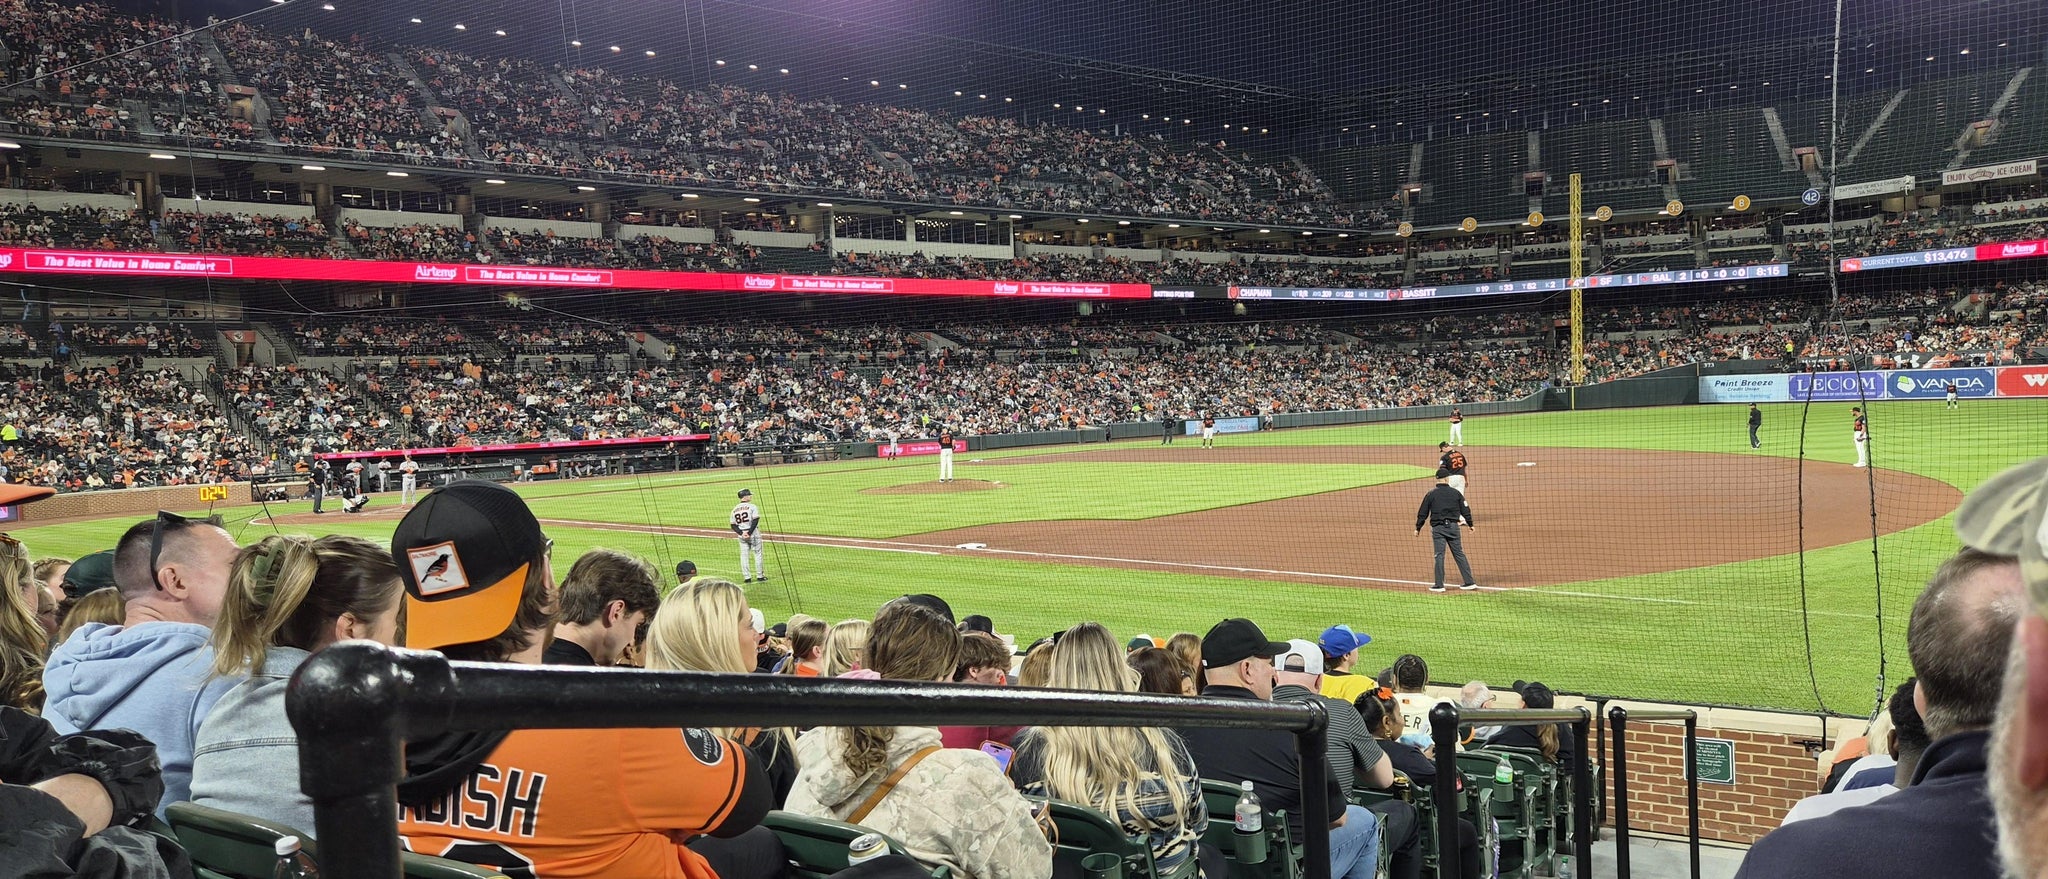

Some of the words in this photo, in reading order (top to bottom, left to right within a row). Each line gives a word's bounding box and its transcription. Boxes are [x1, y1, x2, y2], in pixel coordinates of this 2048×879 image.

[1996, 166, 2008, 176] ICE
[2010, 164, 2032, 175] CREAM
[1946, 172, 1966, 182] ENJOY
[1804, 192, 1818, 201] 42
[1598, 208, 1610, 217] 22
[1669, 203, 1680, 212] 33
[1400, 225, 1411, 234] 20
[2002, 244, 2037, 256] Airtemp
[44, 256, 64, 266] The
[67, 257, 92, 268] Best
[95, 258, 125, 269] Value
[128, 258, 138, 269] in
[141, 258, 171, 270] Home
[174, 260, 216, 271] Comfort
[1862, 257, 1894, 266] CURRENT
[1895, 255, 1918, 264] TOTAL
[1924, 250, 1968, 263] $13,476
[416, 265, 457, 280] Airtemp
[480, 270, 494, 279] The
[496, 271, 514, 280] Best
[516, 271, 537, 280] Value
[539, 272, 546, 280] in
[549, 272, 569, 282] Home
[571, 273, 600, 282] Comfort
[1600, 277, 1612, 285] SF
[1652, 274, 1672, 282] BAL
[1679, 272, 1686, 280] 2
[1756, 266, 1780, 276] 8:15
[744, 276, 776, 288] Airtemp
[1240, 289, 1272, 297] CHAPMAN
[1402, 288, 1437, 298] BASSITT
[1797, 377, 1876, 391] LECOM
[1917, 377, 1985, 389] VANDA
[1452, 458, 1464, 468] 25
[735, 512, 749, 524] 82
